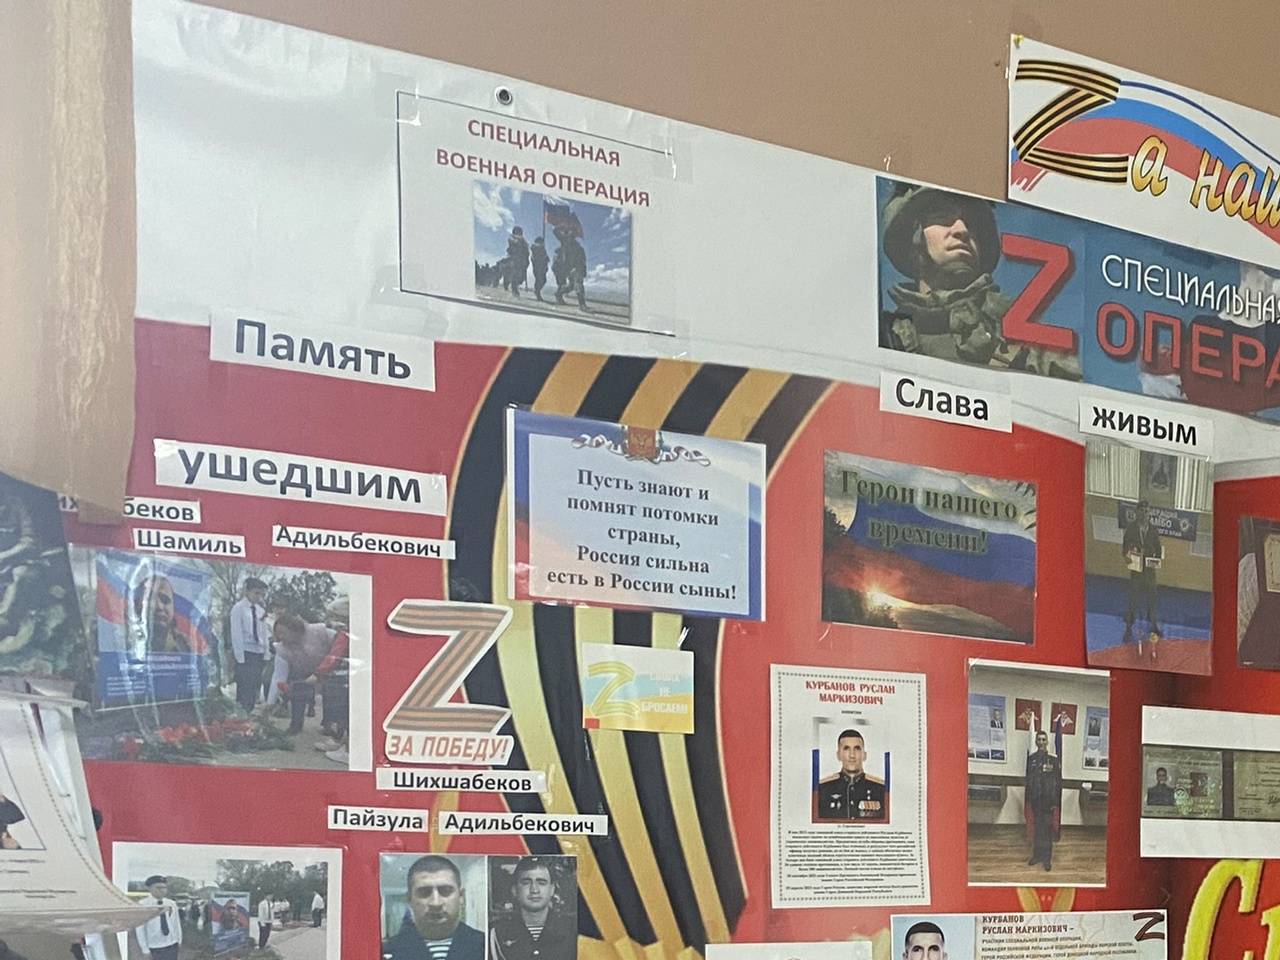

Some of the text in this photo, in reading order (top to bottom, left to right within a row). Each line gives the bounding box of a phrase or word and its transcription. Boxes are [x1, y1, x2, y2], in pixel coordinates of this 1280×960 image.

[466, 119, 621, 167] СПЕЦИАЛЬНАЯ
[436, 148, 650, 207] ВОЕННАЯ ОПЕРАЦИЯ
[234, 320, 411, 379] Память
[896, 378, 1197, 445] Слава живым
[178, 447, 421, 503] ушедшим
[577, 469, 709, 500] Пусть знают и
[841, 470, 1019, 521] Герои нашего
[567, 497, 719, 525] помнят потомки
[137, 529, 242, 554] Шамиль
[276, 526, 441, 557] Адильбекович
[608, 526, 680, 549] страны,
[869, 518, 988, 553] времени!
[577, 545, 709, 573] Россия сильна
[547, 571, 737, 600] есть в России сыны!
[805, 681, 895, 694] КУРБАНОВ РУСЛАН
[819, 693, 883, 705] МАРКИЗОВИЧ
[388, 736, 510, 761] ЗА ПОБЕДУ!
[394, 772, 532, 791] Шихшабеков
[332, 807, 595, 832] Пайзула Адильбекович
[982, 915, 1025, 924] КУРБАНОВ
[982, 924, 1068, 935] РУСЛАН МАРКИЗОВИЧ
